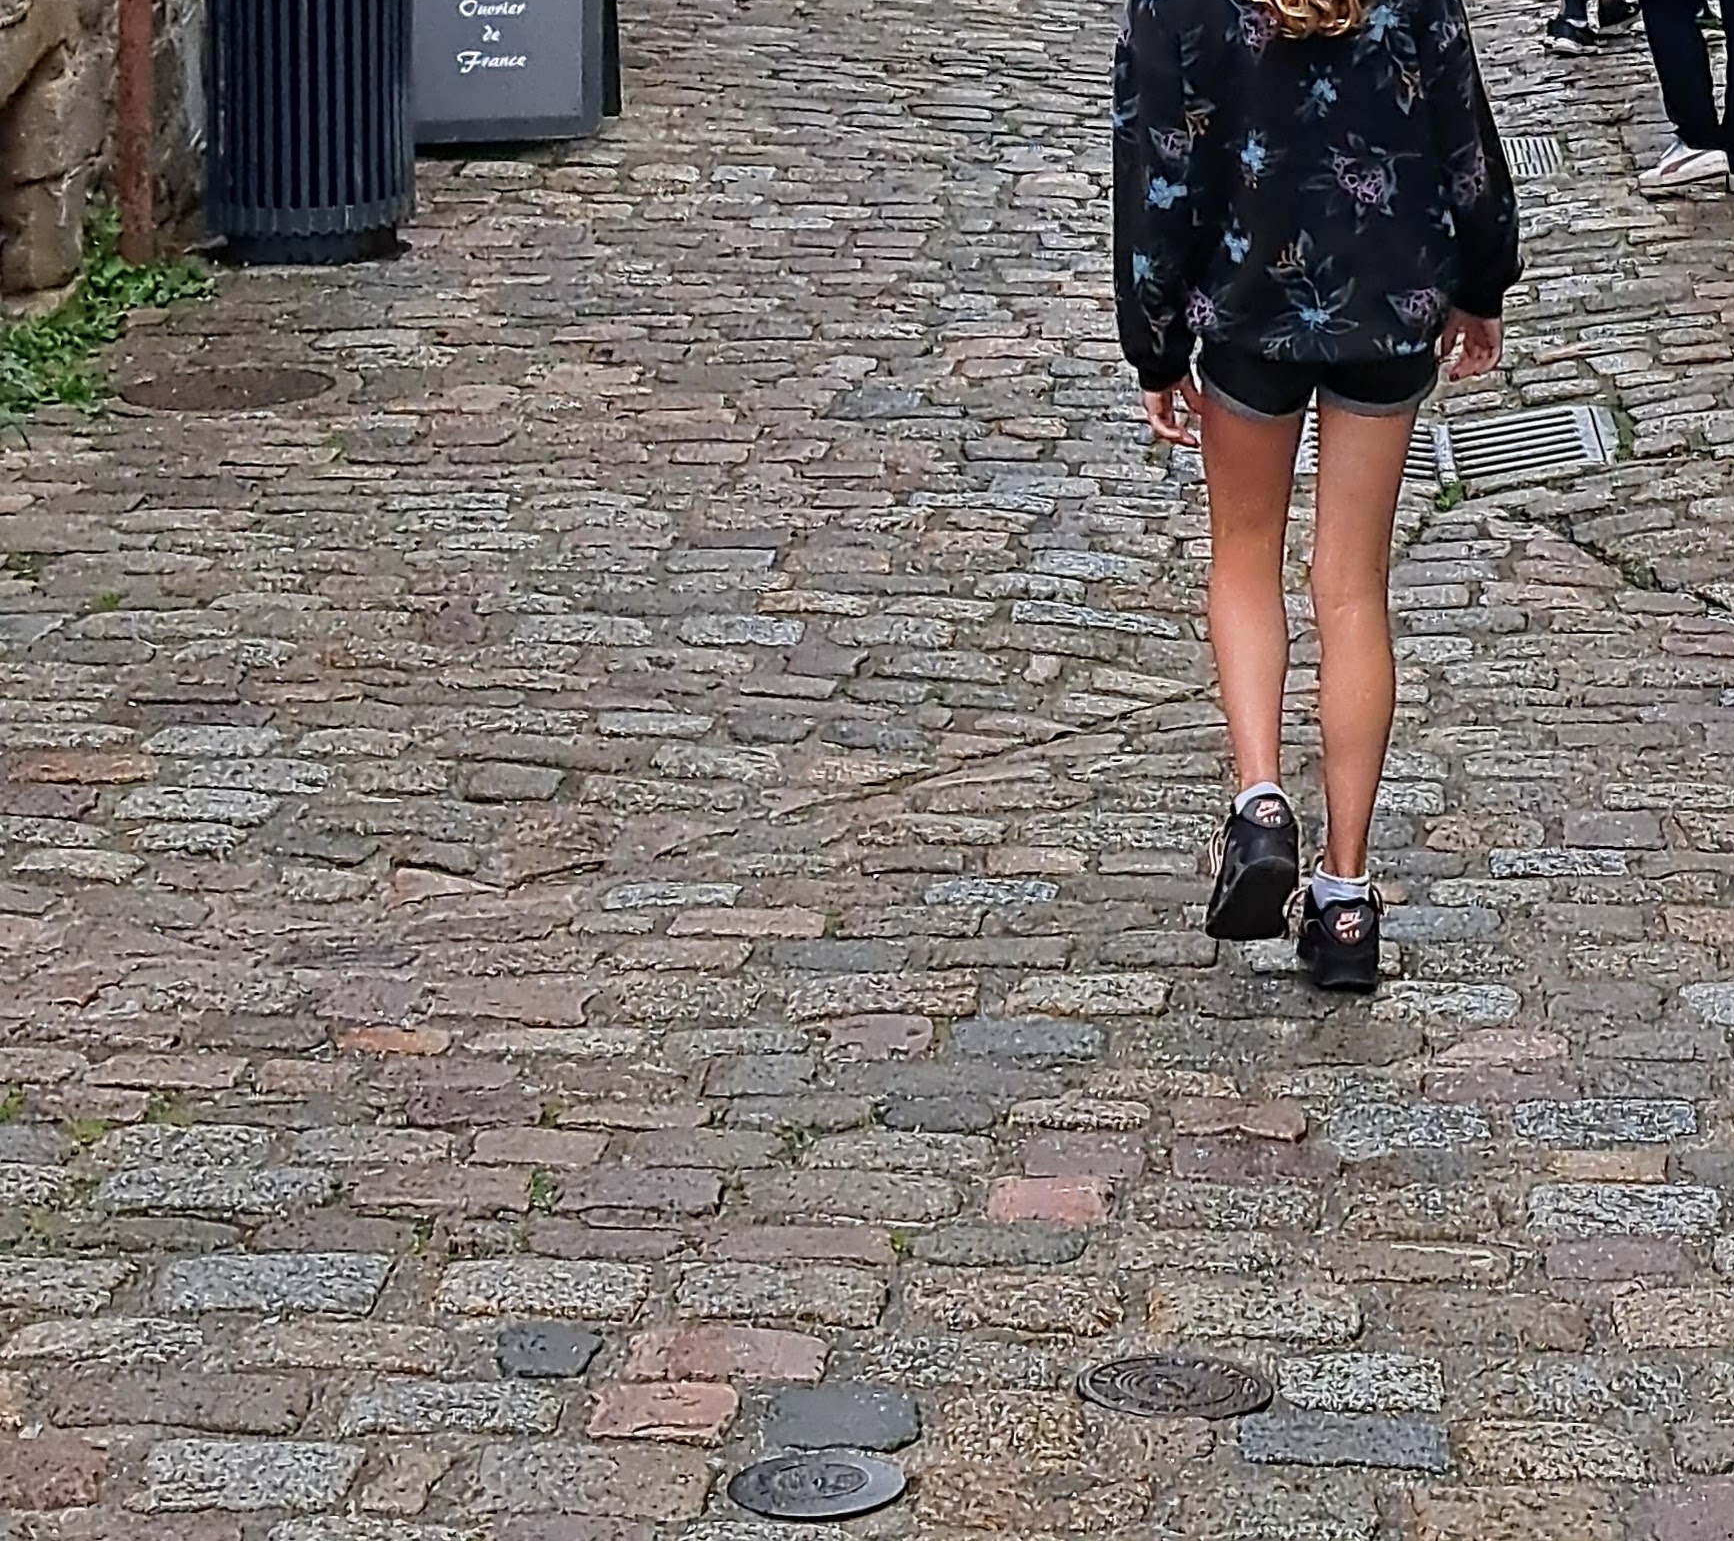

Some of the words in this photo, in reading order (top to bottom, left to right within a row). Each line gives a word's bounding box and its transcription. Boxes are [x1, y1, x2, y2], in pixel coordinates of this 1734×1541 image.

[459, 0, 525, 17] Ouvrier
[482, 25, 500, 42] de
[456, 50, 526, 73] France
